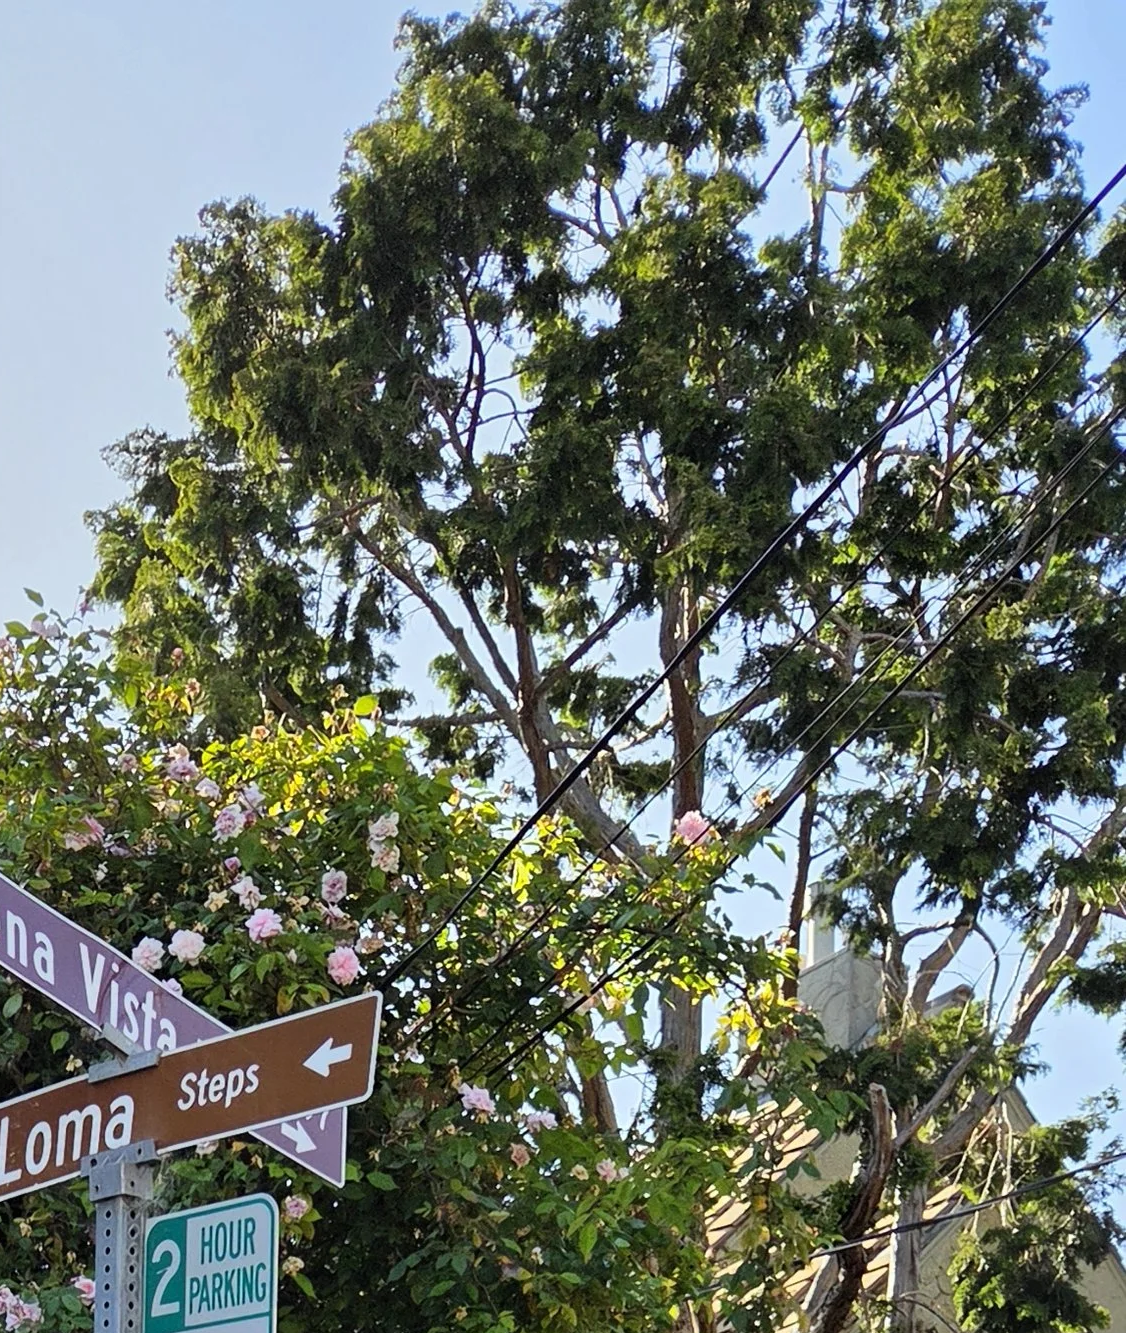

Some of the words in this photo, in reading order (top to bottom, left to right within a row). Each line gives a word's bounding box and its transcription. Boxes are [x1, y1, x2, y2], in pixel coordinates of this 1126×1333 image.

[80, 943, 177, 1051] Vista
[177, 1063, 260, 1111] Steps
[200, 1217, 256, 1265] HOUR
[151, 1239, 181, 1318] 2
[189, 1262, 267, 1316] PARKING
